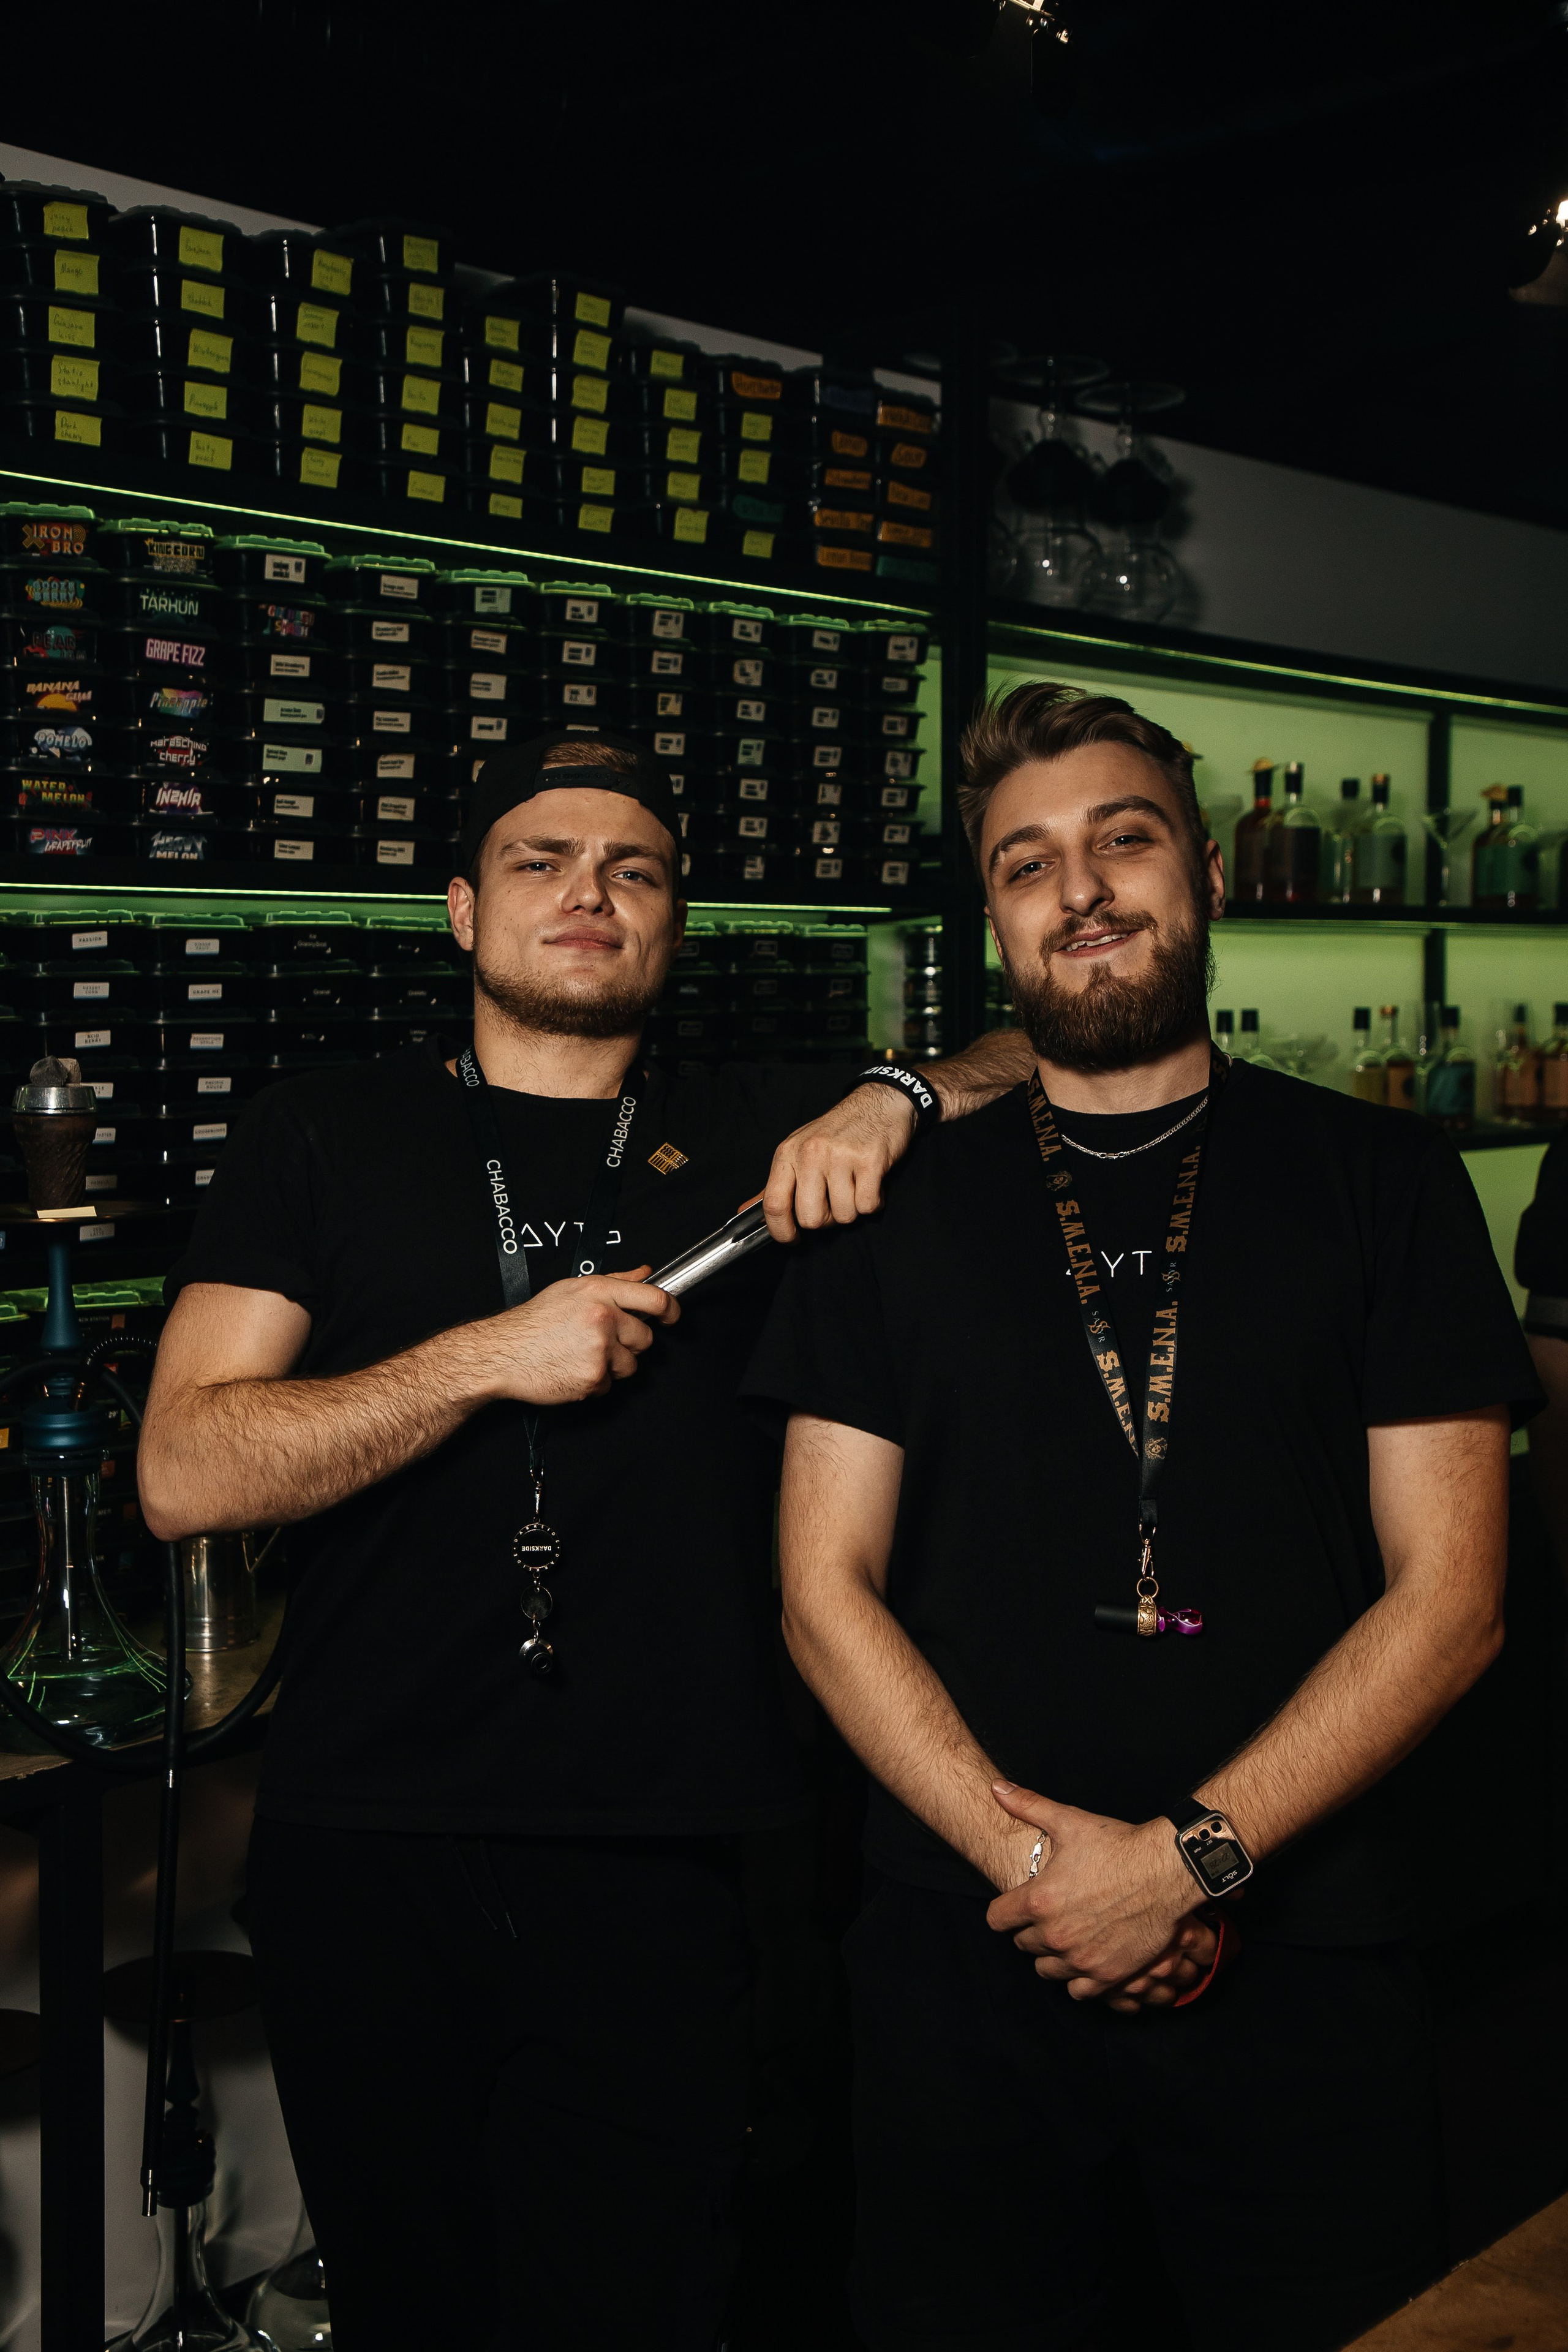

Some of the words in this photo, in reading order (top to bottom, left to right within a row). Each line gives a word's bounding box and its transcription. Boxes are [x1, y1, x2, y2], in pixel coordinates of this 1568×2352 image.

[60, 263, 83, 277] Mango
[32, 523, 73, 539] IRON
[52, 540, 85, 554] BRO
[34, 591, 75, 603] BERRY
[140, 595, 199, 616] TARHUN
[32, 631, 76, 650] PEAR
[146, 638, 181, 663] GRAPE
[182, 643, 206, 667] FIZZ
[26, 680, 80, 695] BANANA
[66, 690, 92, 703] GUM
[150, 692, 208, 714] Pineapple
[37, 732, 89, 748] POMELO
[22, 778, 66, 793] WATER
[42, 791, 85, 805] MELON
[30, 828, 78, 843] PINK
[45, 837, 92, 853] GRAPEFRUIT
[156, 850, 198, 860] MELON
[858, 1066, 933, 1109] DARKSID
[606, 1096, 636, 1167] CHABACCO
[486, 1159, 518, 1254] CHABACCO
[1055, 1199, 1101, 1305] S.M.E.N.A.
[1147, 1300, 1178, 1424] S.M.E.N.A.
